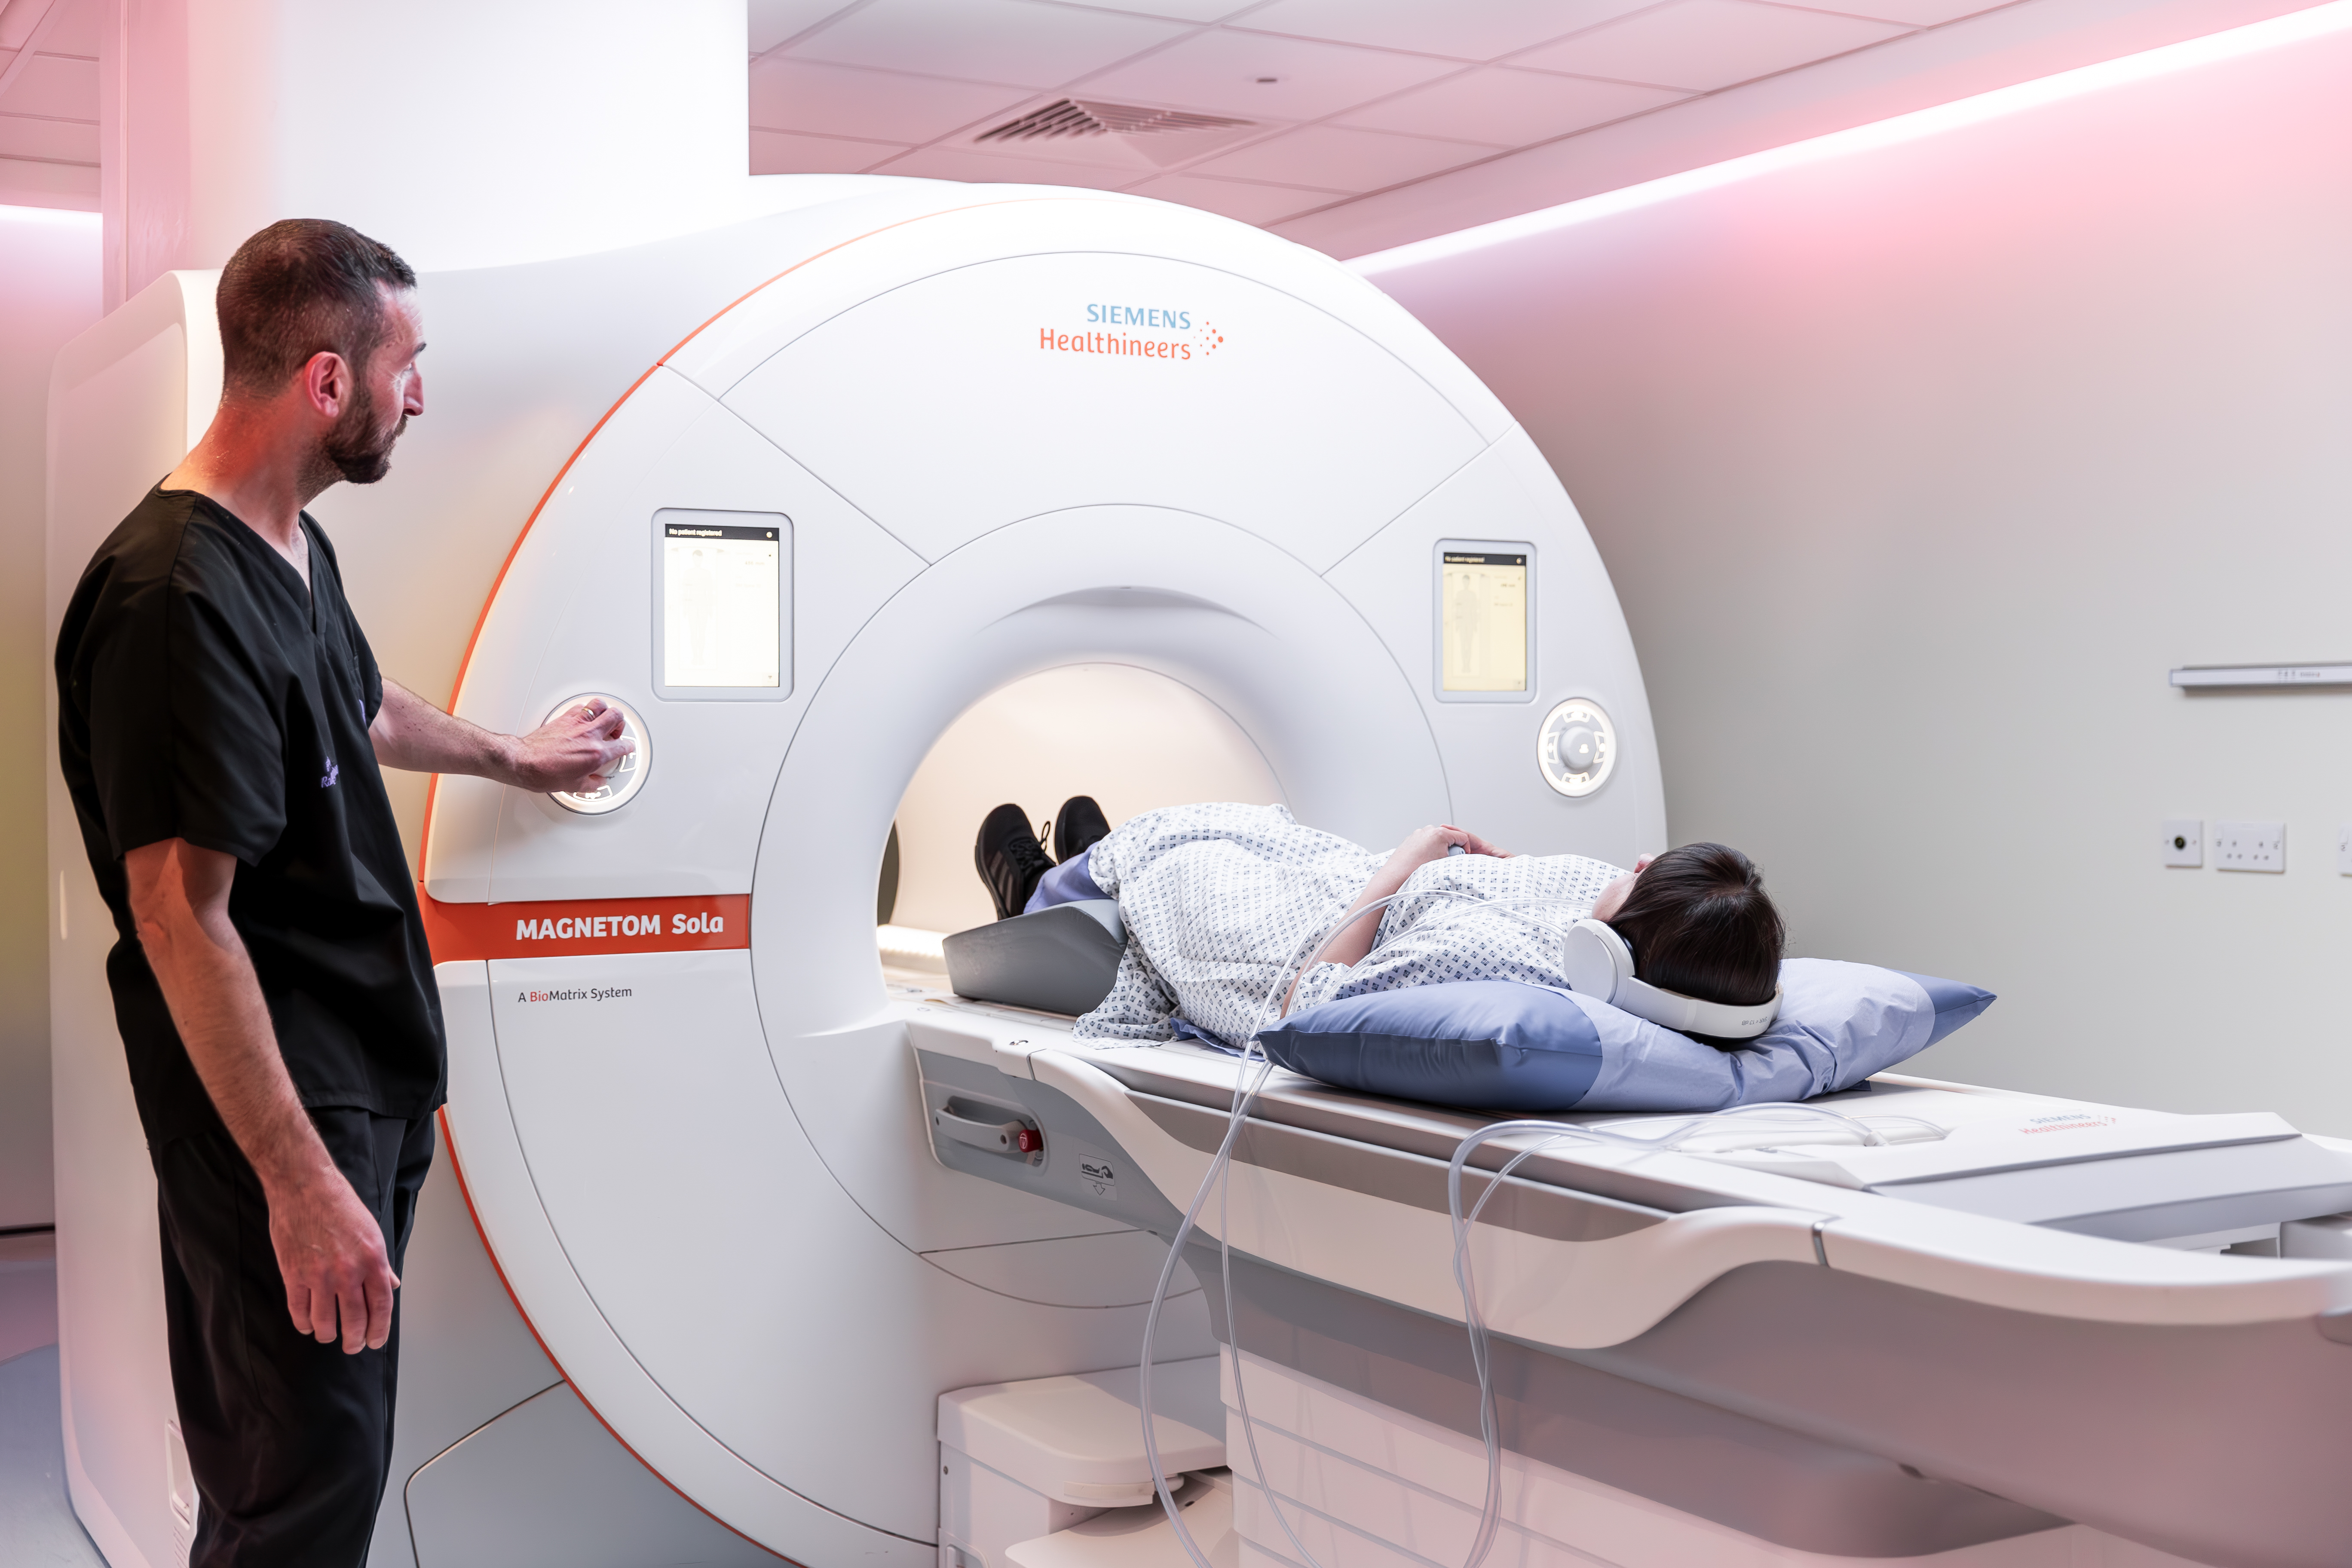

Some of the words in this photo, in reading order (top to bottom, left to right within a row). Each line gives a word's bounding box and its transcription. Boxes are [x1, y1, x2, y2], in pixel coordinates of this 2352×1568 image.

[1087, 304, 1191, 329] SIEMENS
[1040, 328, 1191, 360] Healthineers
[516, 914, 661, 940] MAGNETOM
[671, 912, 724, 934] Sola
[518, 992, 527, 1003] A
[530, 988, 588, 1002] BioMatrix
[591, 987, 632, 1001] System
[2018, 1121, 2108, 1134] Healthineers
[2029, 1114, 2091, 1124] SIEMENS
